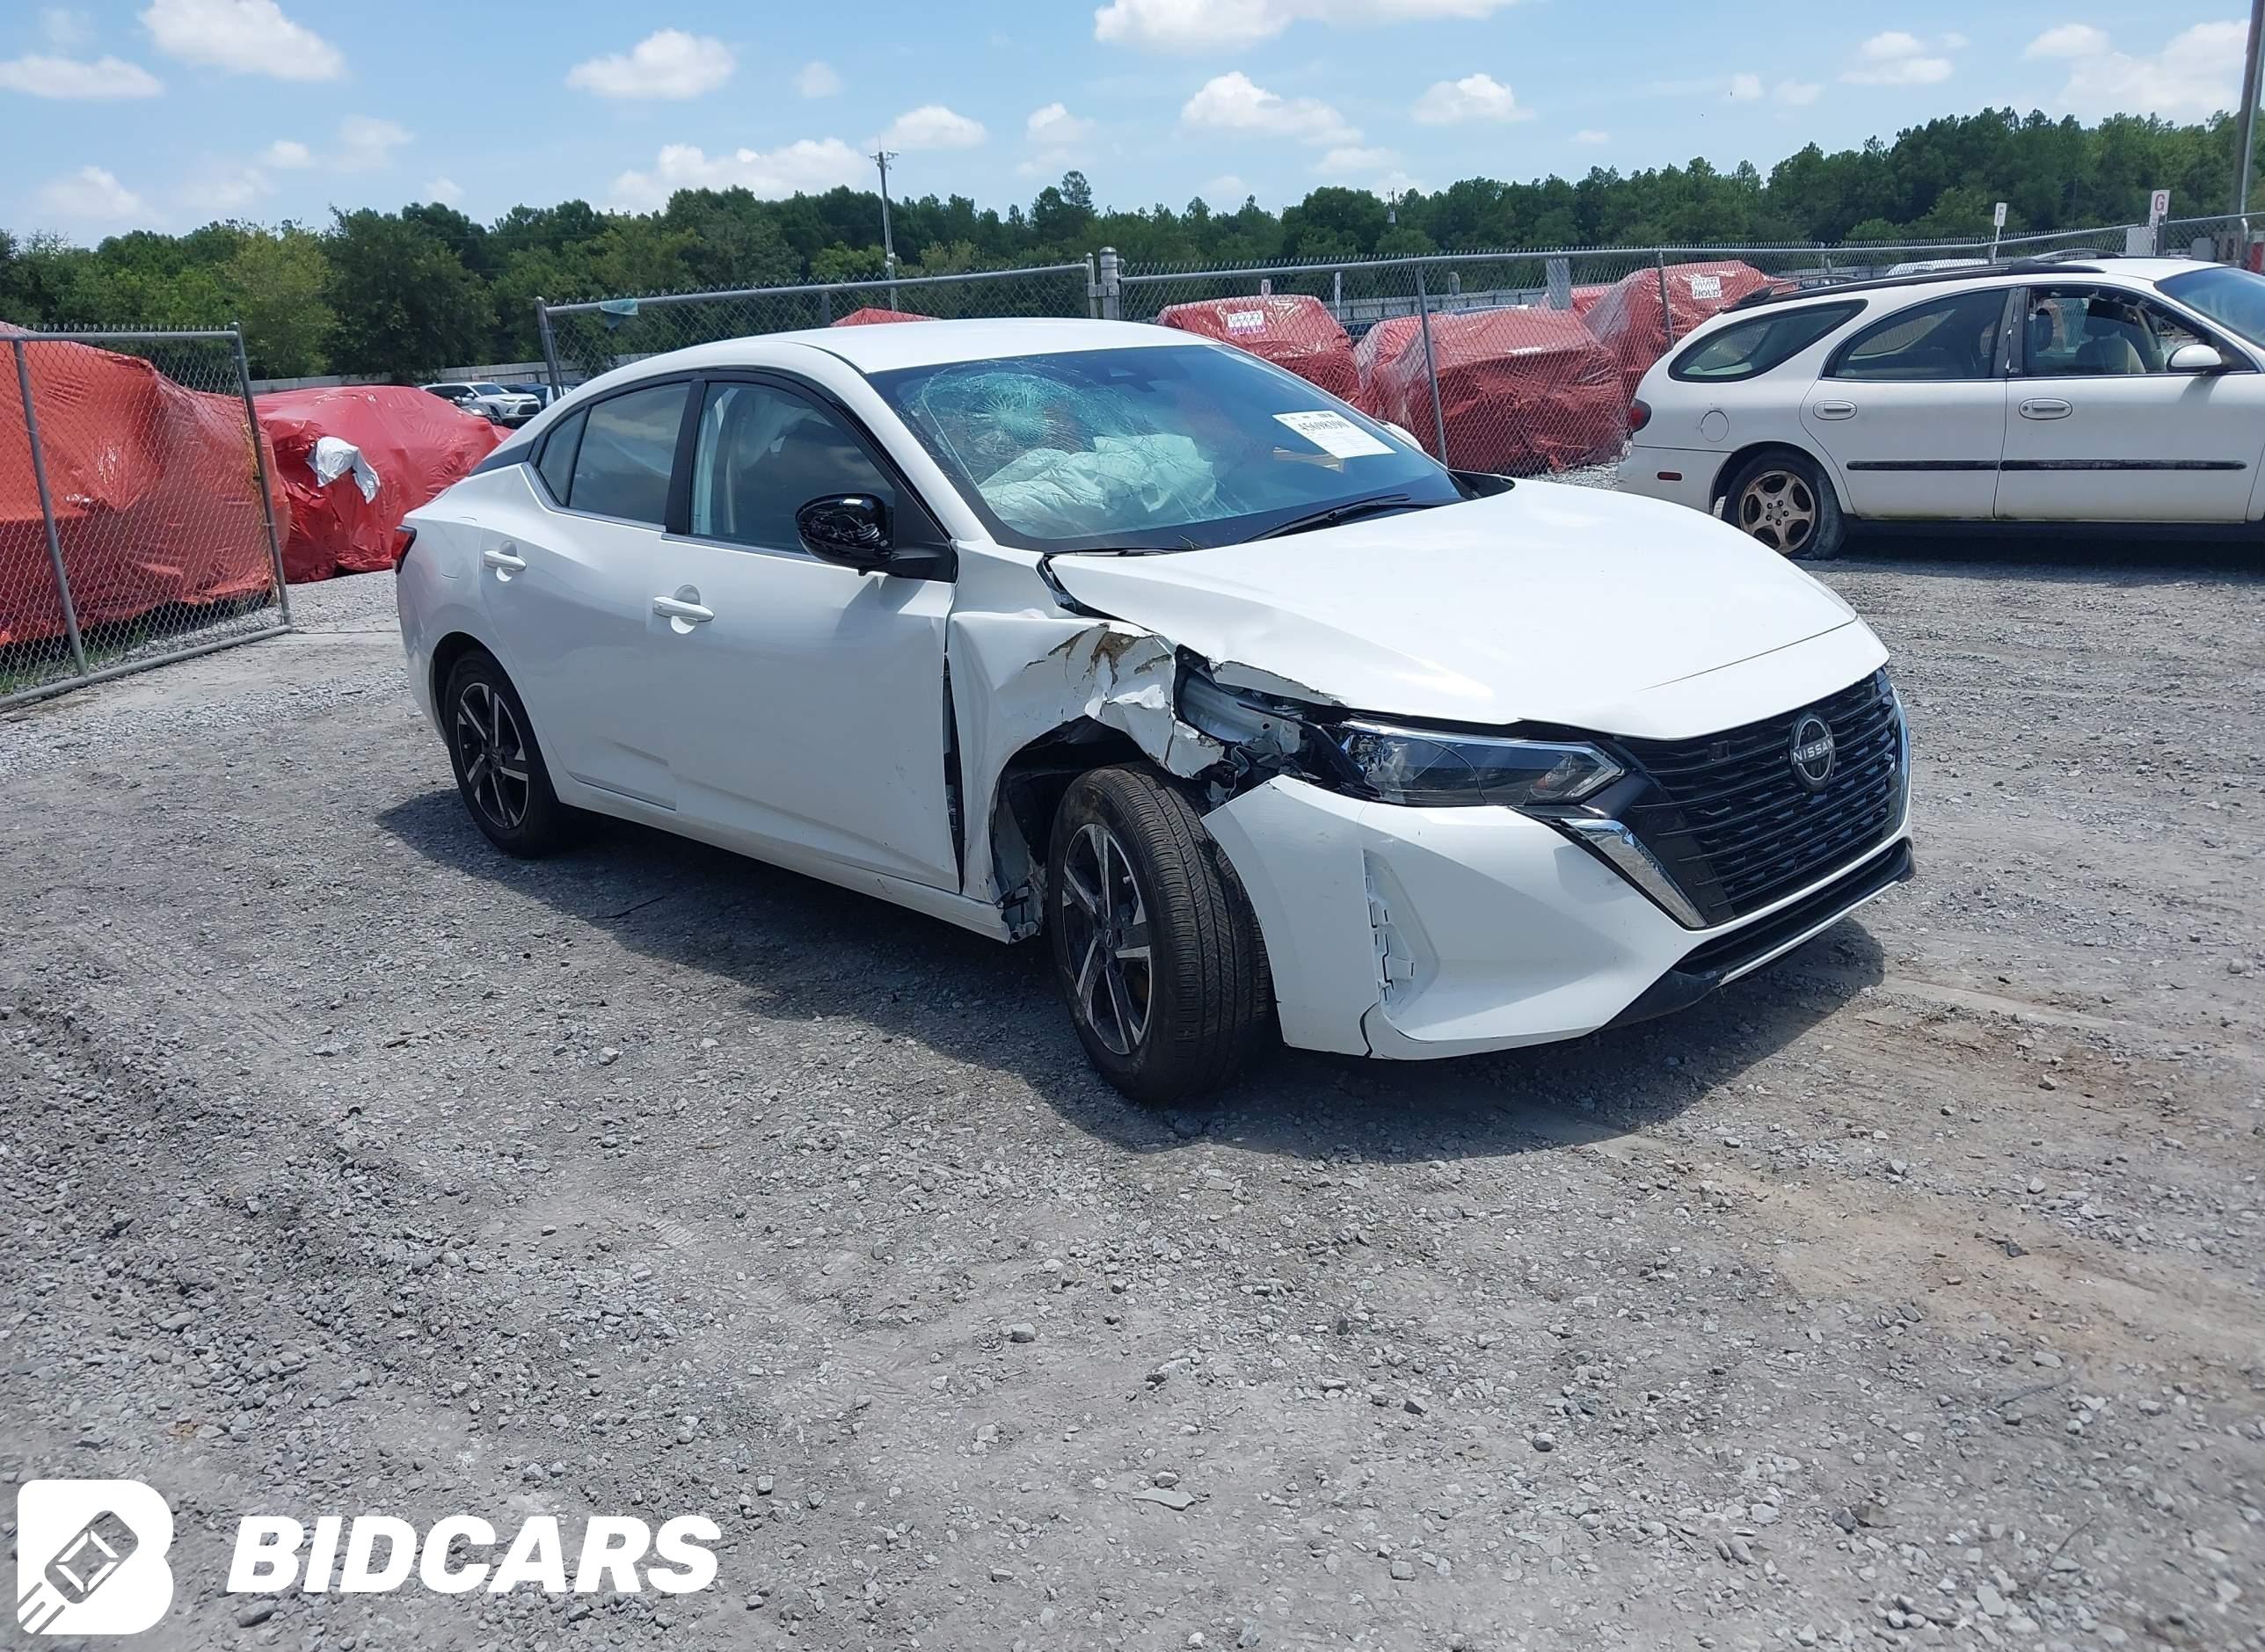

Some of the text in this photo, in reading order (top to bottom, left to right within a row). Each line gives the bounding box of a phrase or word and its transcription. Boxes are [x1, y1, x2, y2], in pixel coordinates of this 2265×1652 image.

[2155, 193, 2165, 211] G
[1997, 207, 2004, 222] F
[1694, 288, 1720, 297] HOLD
[1793, 739, 1834, 762] NISSAN
